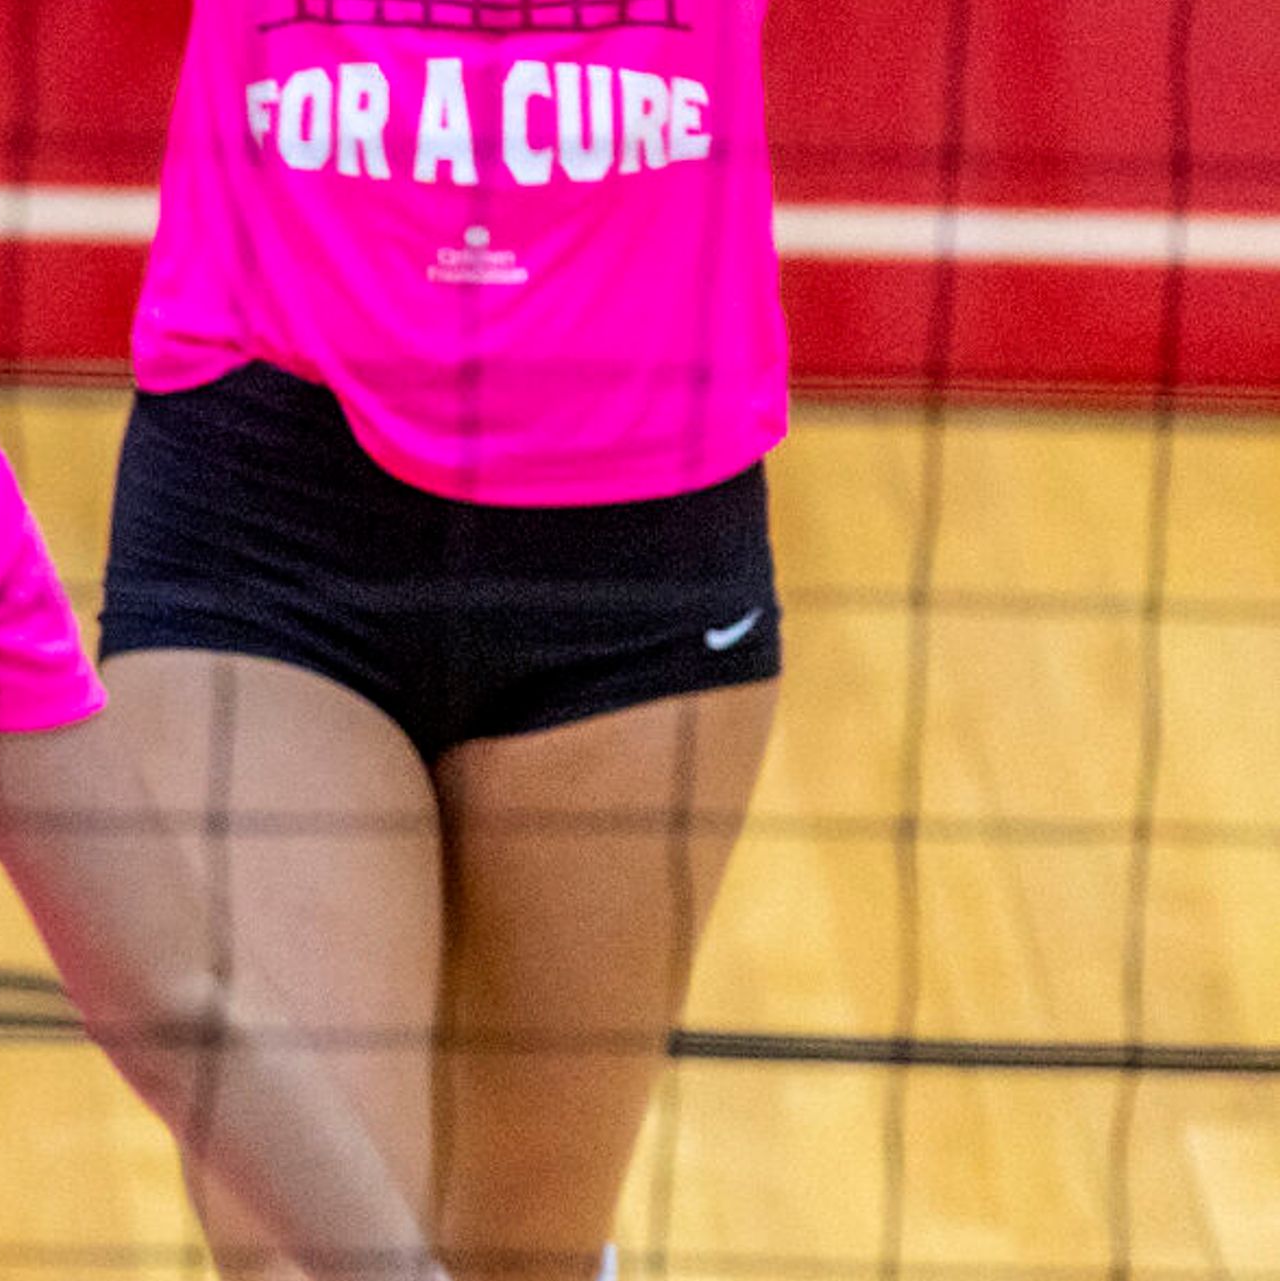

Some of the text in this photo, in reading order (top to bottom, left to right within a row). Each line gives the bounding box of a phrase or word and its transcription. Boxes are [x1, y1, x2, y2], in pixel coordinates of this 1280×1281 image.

[245, 57, 713, 186] FOR A CURE
